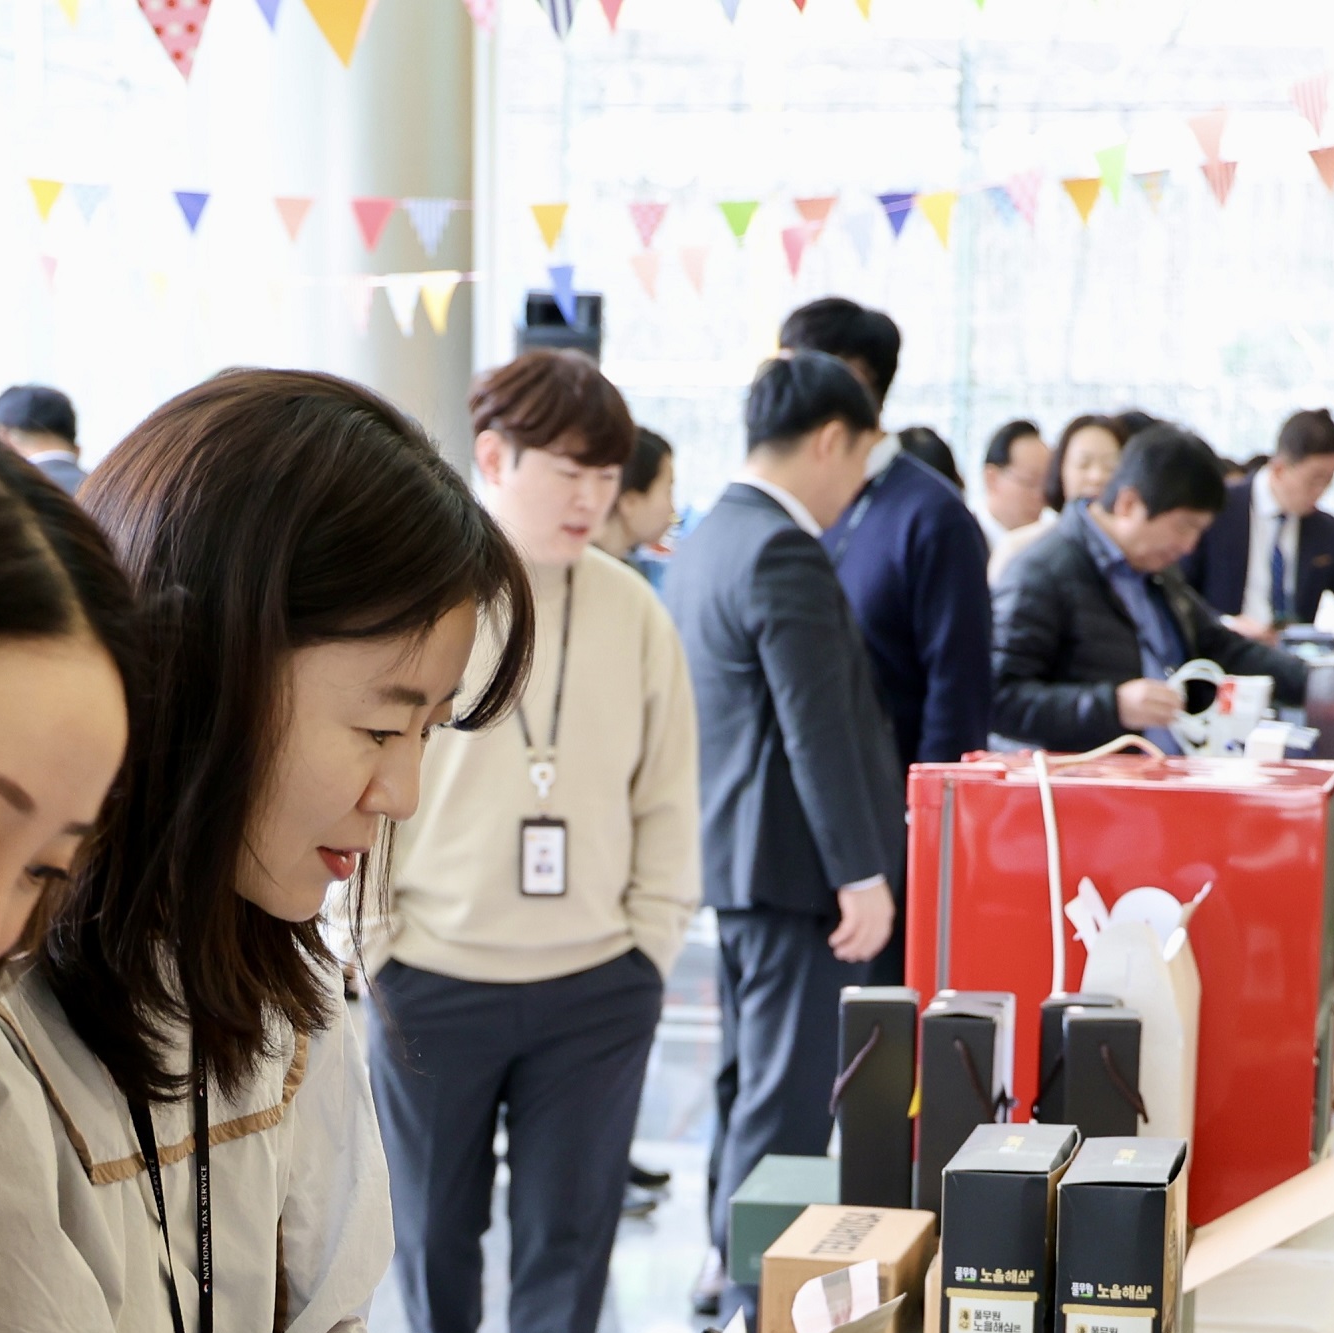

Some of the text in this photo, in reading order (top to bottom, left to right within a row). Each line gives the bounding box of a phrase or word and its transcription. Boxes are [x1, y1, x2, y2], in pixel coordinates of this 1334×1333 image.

[200, 1164, 208, 1206] SERVICE
[202, 1231, 210, 1280] NATIONAL
[954, 1266, 1031, 1285] 풀무원 노을해심
[1070, 1282, 1149, 1302] 풀무원 노을해심
[973, 1308, 1001, 1321] 풀무원
[973, 1320, 1022, 1333] 노을해심은
